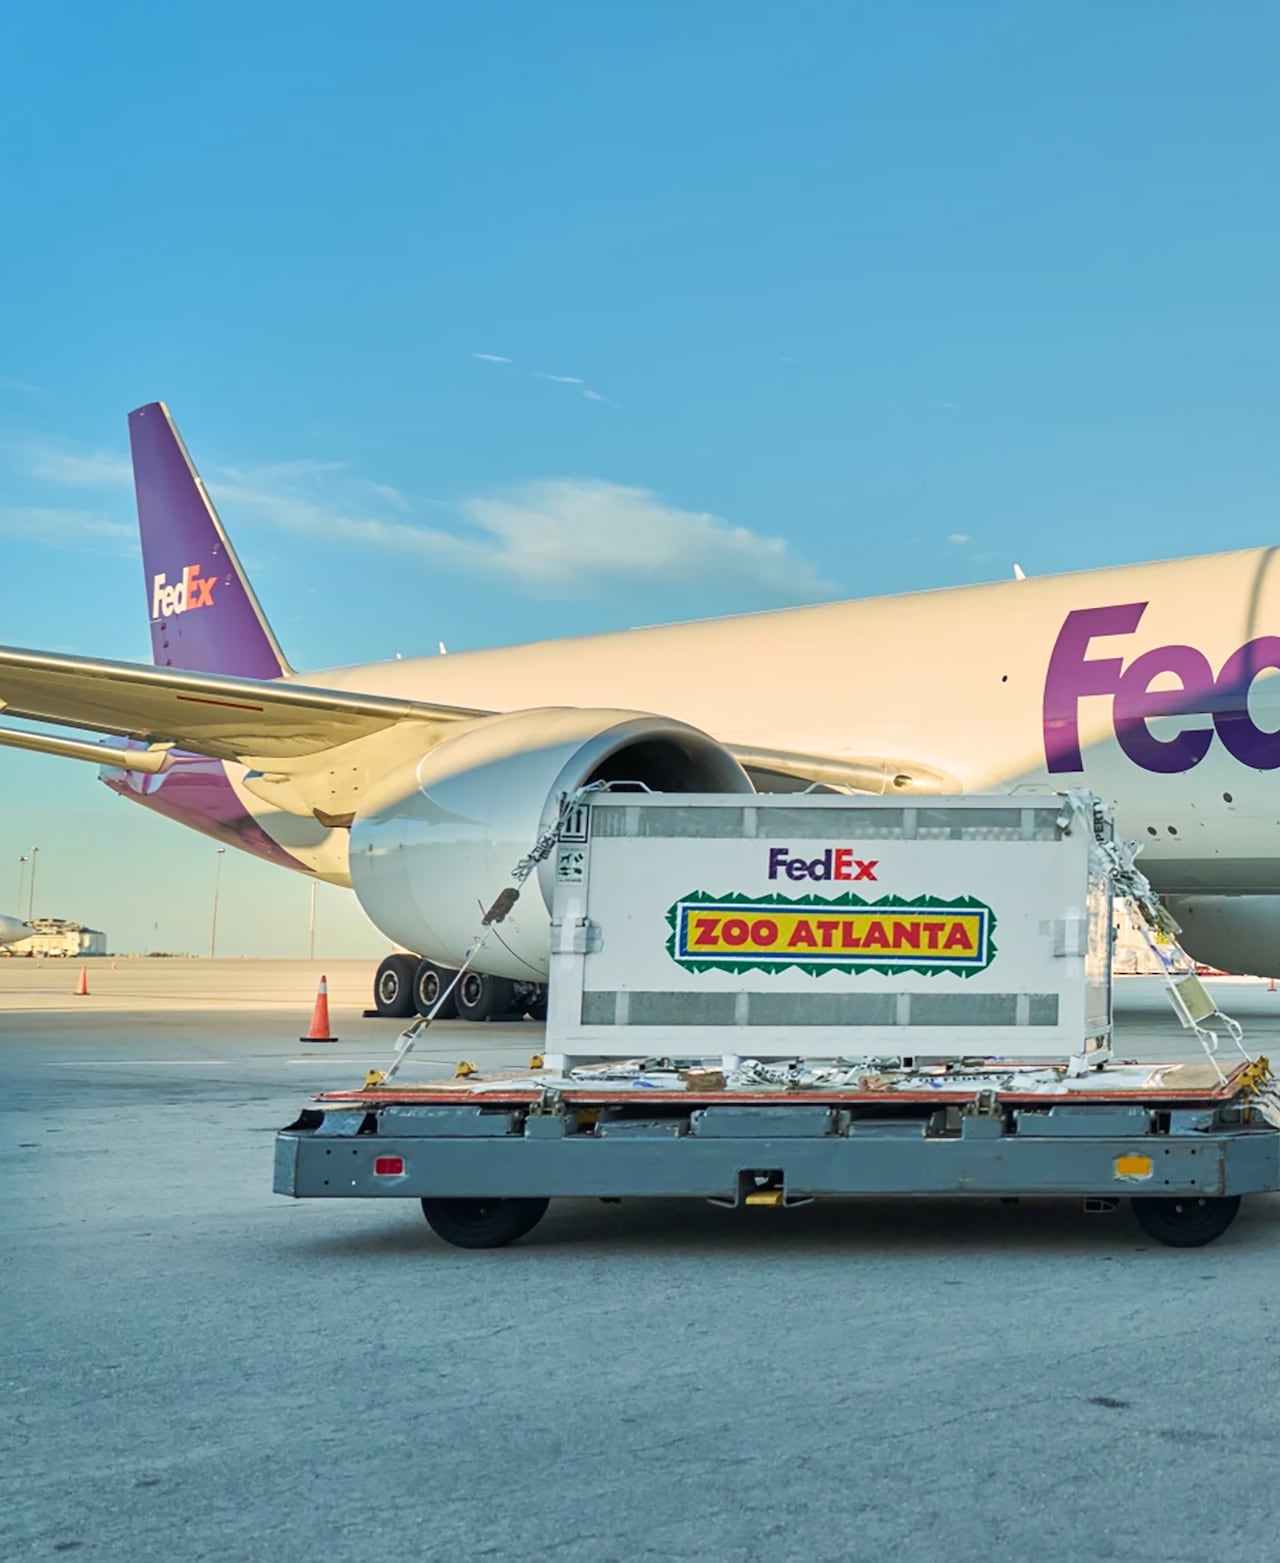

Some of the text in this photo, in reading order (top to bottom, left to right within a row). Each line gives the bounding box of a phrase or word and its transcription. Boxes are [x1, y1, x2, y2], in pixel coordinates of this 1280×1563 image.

[152, 564, 218, 618] FedEx
[768, 847, 879, 881] FedEx
[694, 918, 973, 949] ZOO ATLANTA
